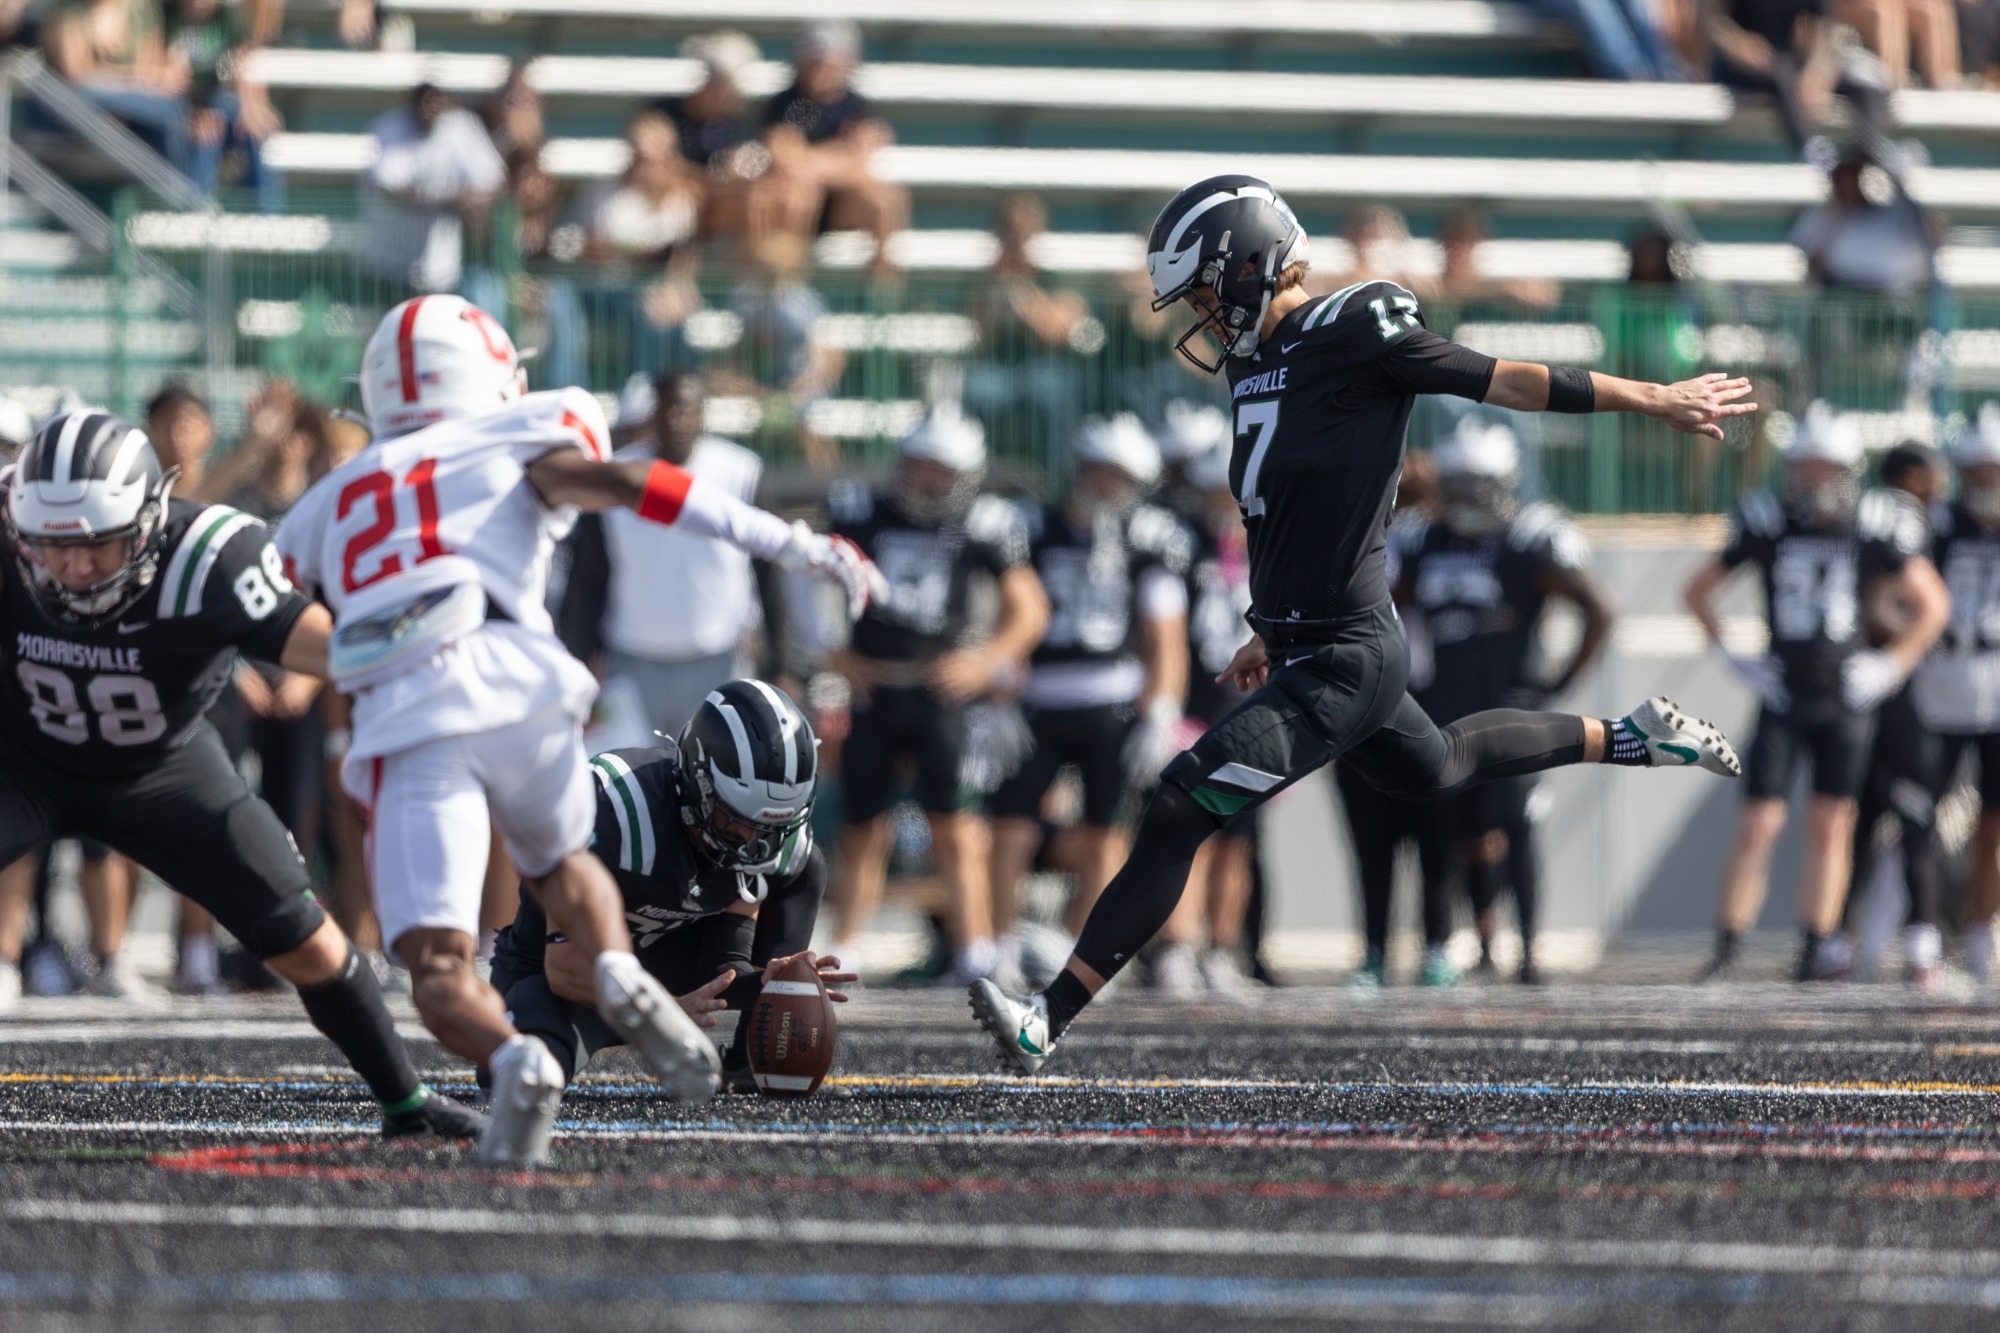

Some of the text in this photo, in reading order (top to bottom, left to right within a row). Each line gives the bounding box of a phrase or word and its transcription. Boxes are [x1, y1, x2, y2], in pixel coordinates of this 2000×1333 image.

[1367, 296, 1420, 342] 17
[337, 458, 454, 594] 21
[17, 631, 143, 673] MORRISVILLE
[16, 659, 168, 746] 88
[775, 1010, 792, 1060] Wilson
